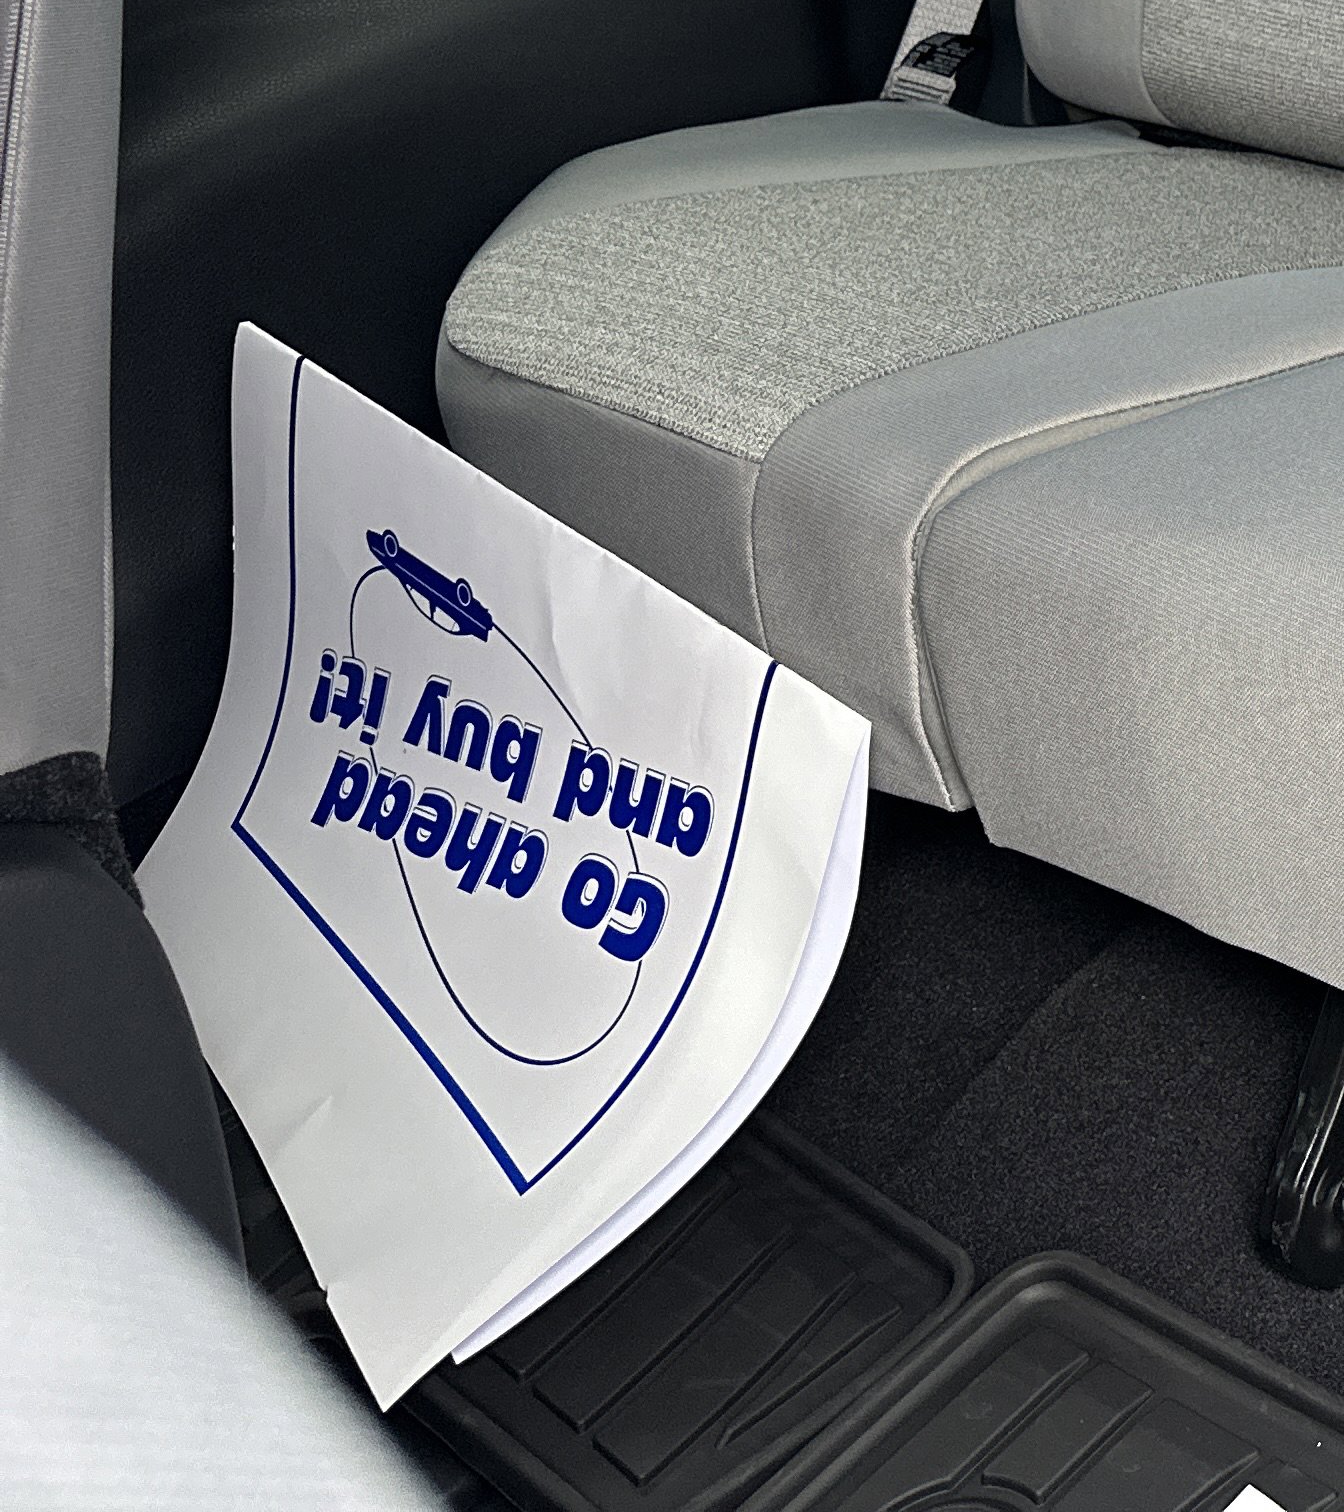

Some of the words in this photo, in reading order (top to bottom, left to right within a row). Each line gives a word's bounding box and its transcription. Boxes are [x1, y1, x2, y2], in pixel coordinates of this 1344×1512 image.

[309, 648, 392, 746] it!
[402, 674, 543, 803] buy
[310, 750, 549, 899] ahead
[553, 739, 715, 857] and
[561, 852, 670, 962] Go
